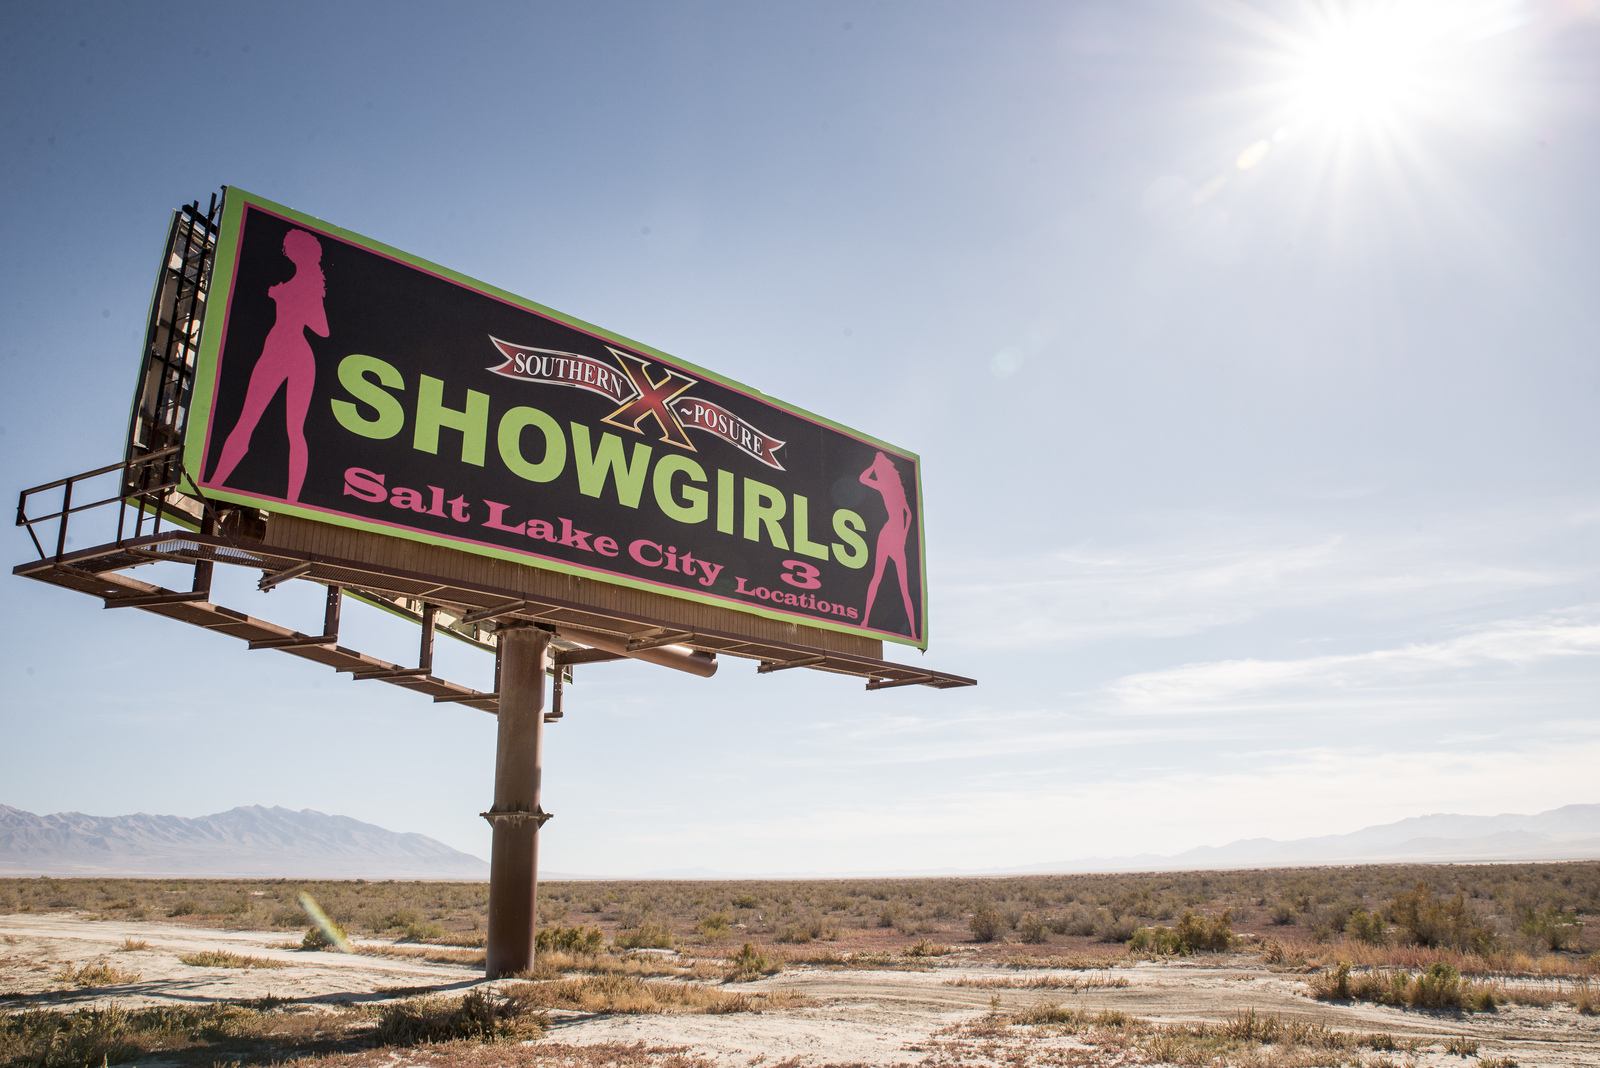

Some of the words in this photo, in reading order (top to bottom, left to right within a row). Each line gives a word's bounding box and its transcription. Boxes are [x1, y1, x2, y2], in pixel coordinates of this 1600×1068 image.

[513, 352, 624, 398] SOUTHERN
[600, 345, 699, 453] X
[330, 354, 869, 570] SHOWGIRLS
[343, 466, 471, 525] Salt
[480, 499, 619, 558] Lake
[628, 539, 725, 586] City
[779, 559, 822, 591] 3
[734, 576, 859, 620] Locations
